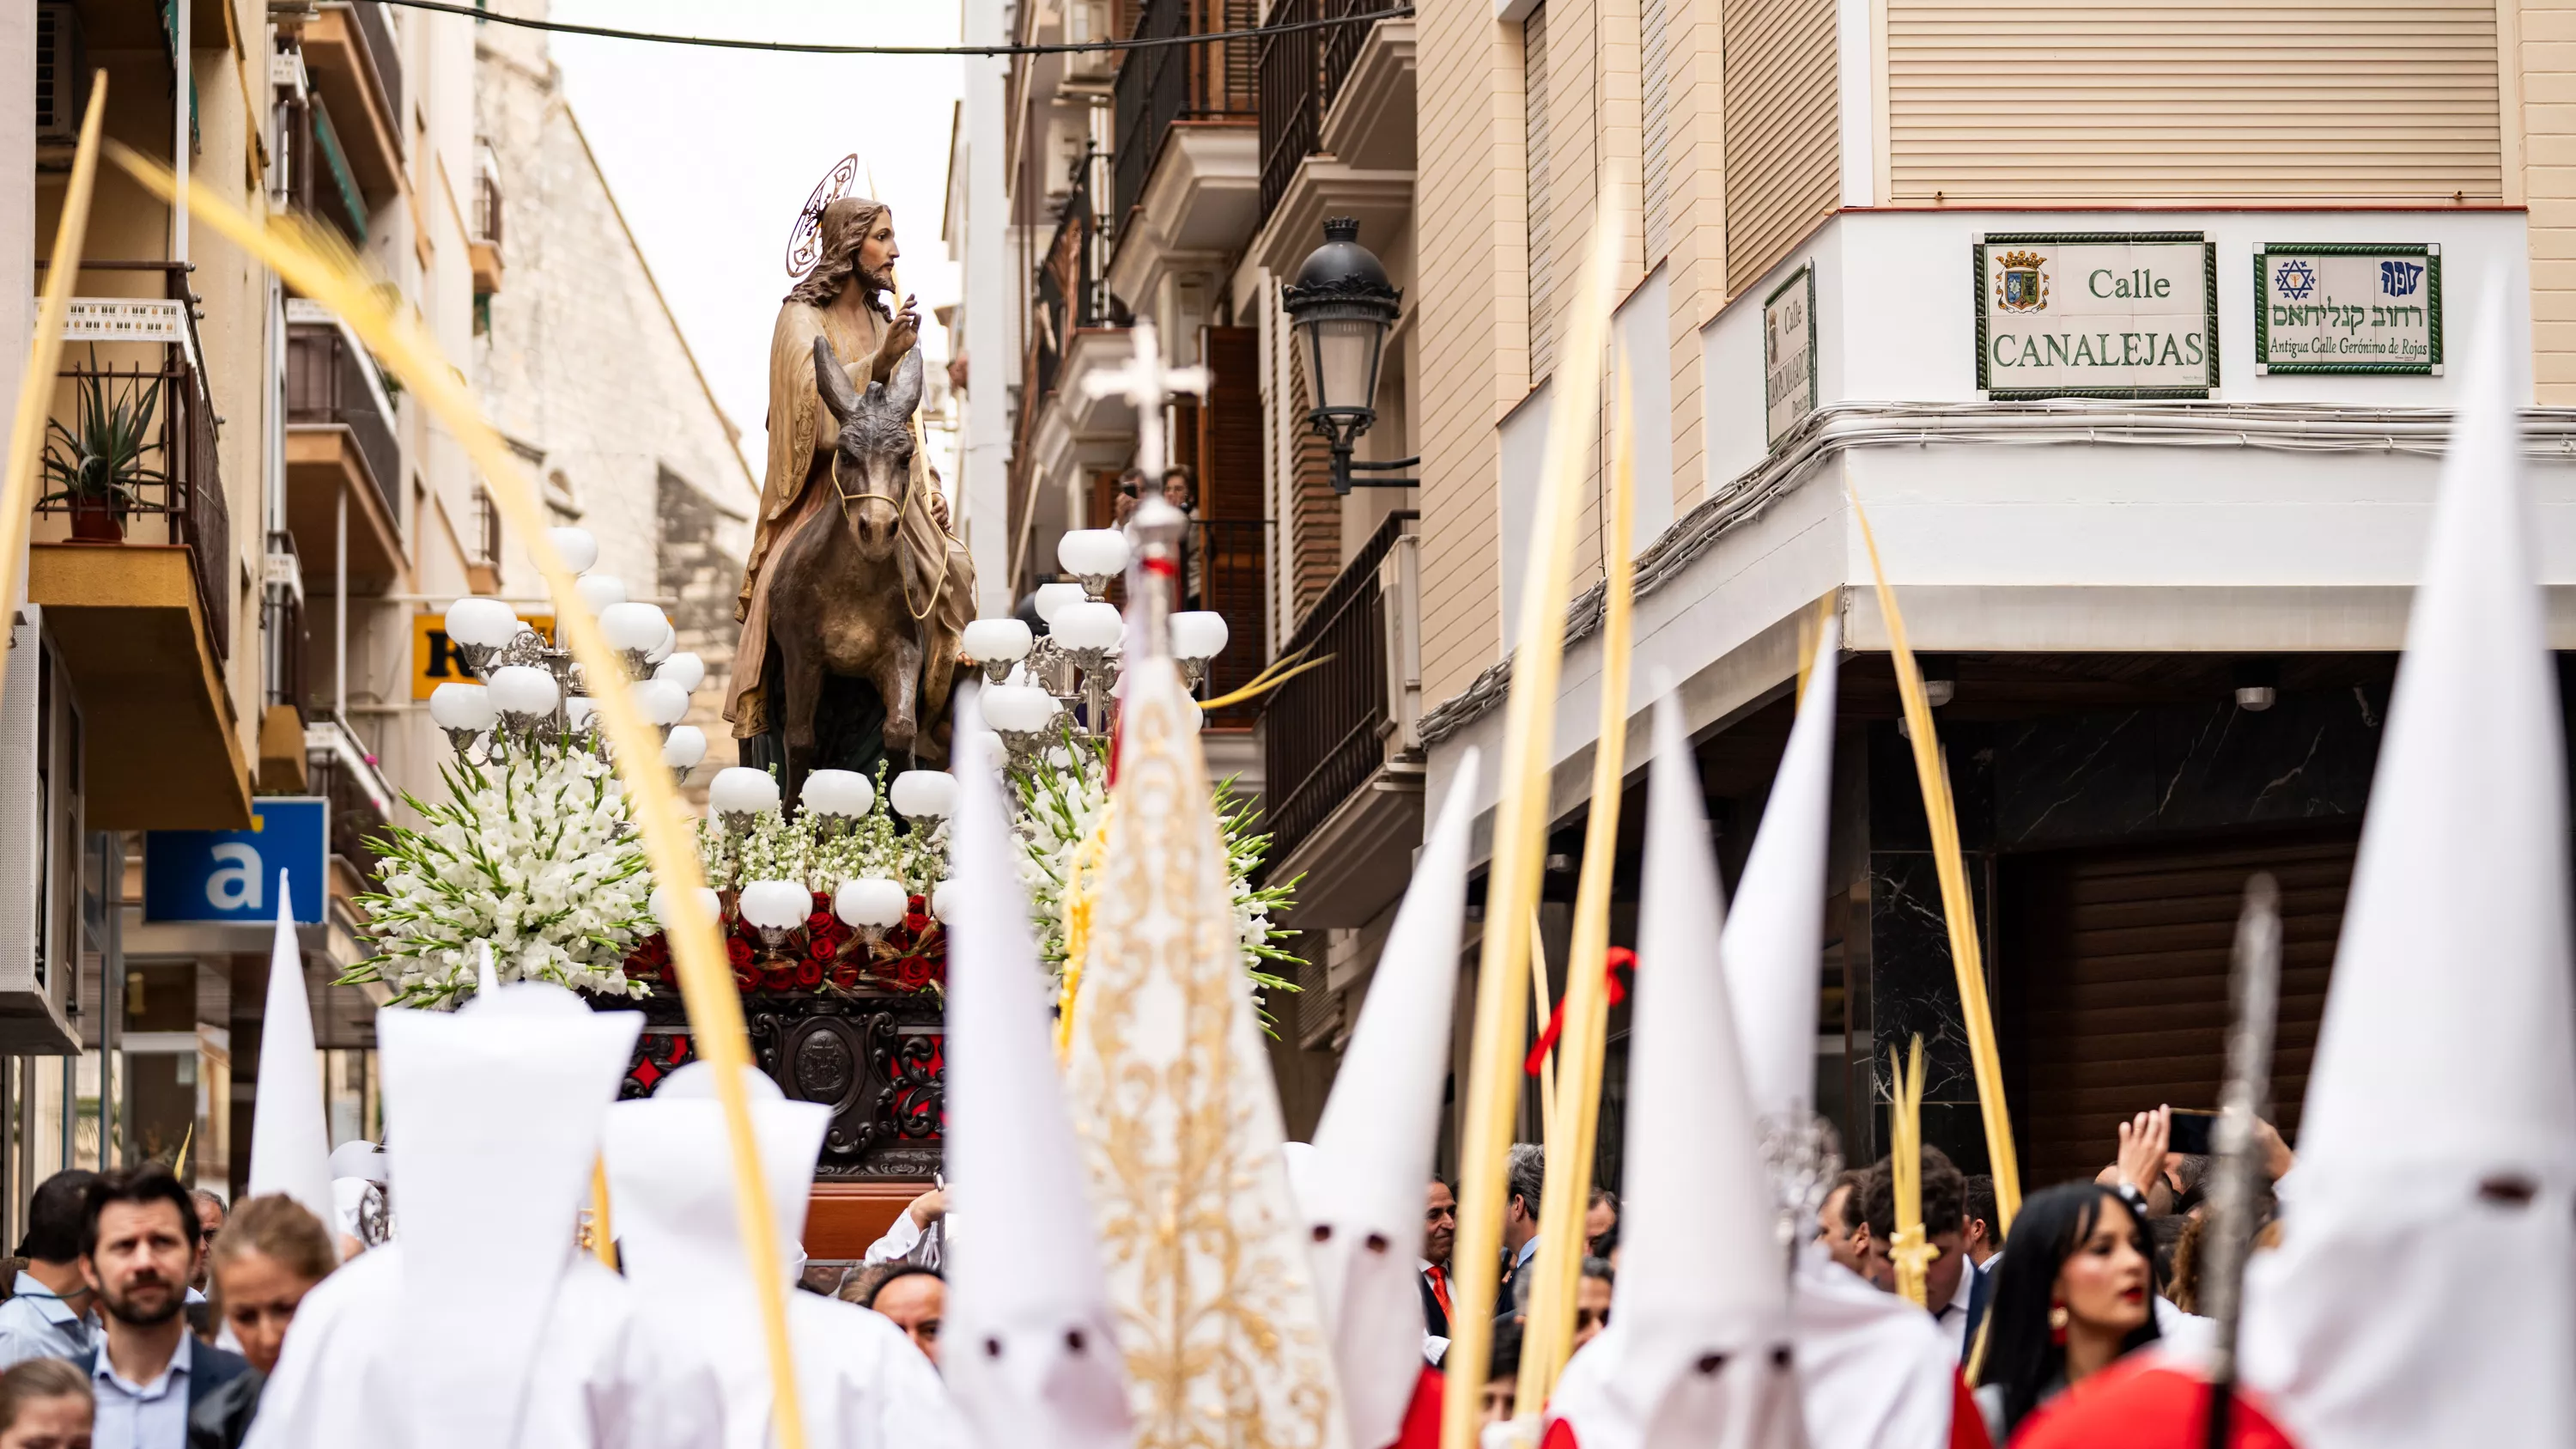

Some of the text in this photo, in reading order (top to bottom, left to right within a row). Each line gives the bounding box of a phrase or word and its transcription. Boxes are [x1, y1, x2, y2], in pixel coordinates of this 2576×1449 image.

[2088, 268, 2171, 299] Calle
[1785, 298, 1801, 335] Calle
[2371, 305, 2423, 327] רחוב
[1992, 332, 2204, 368] CANALEJAS
[2269, 336, 2428, 361] Antigua Calle Gerónimo de Rojas
